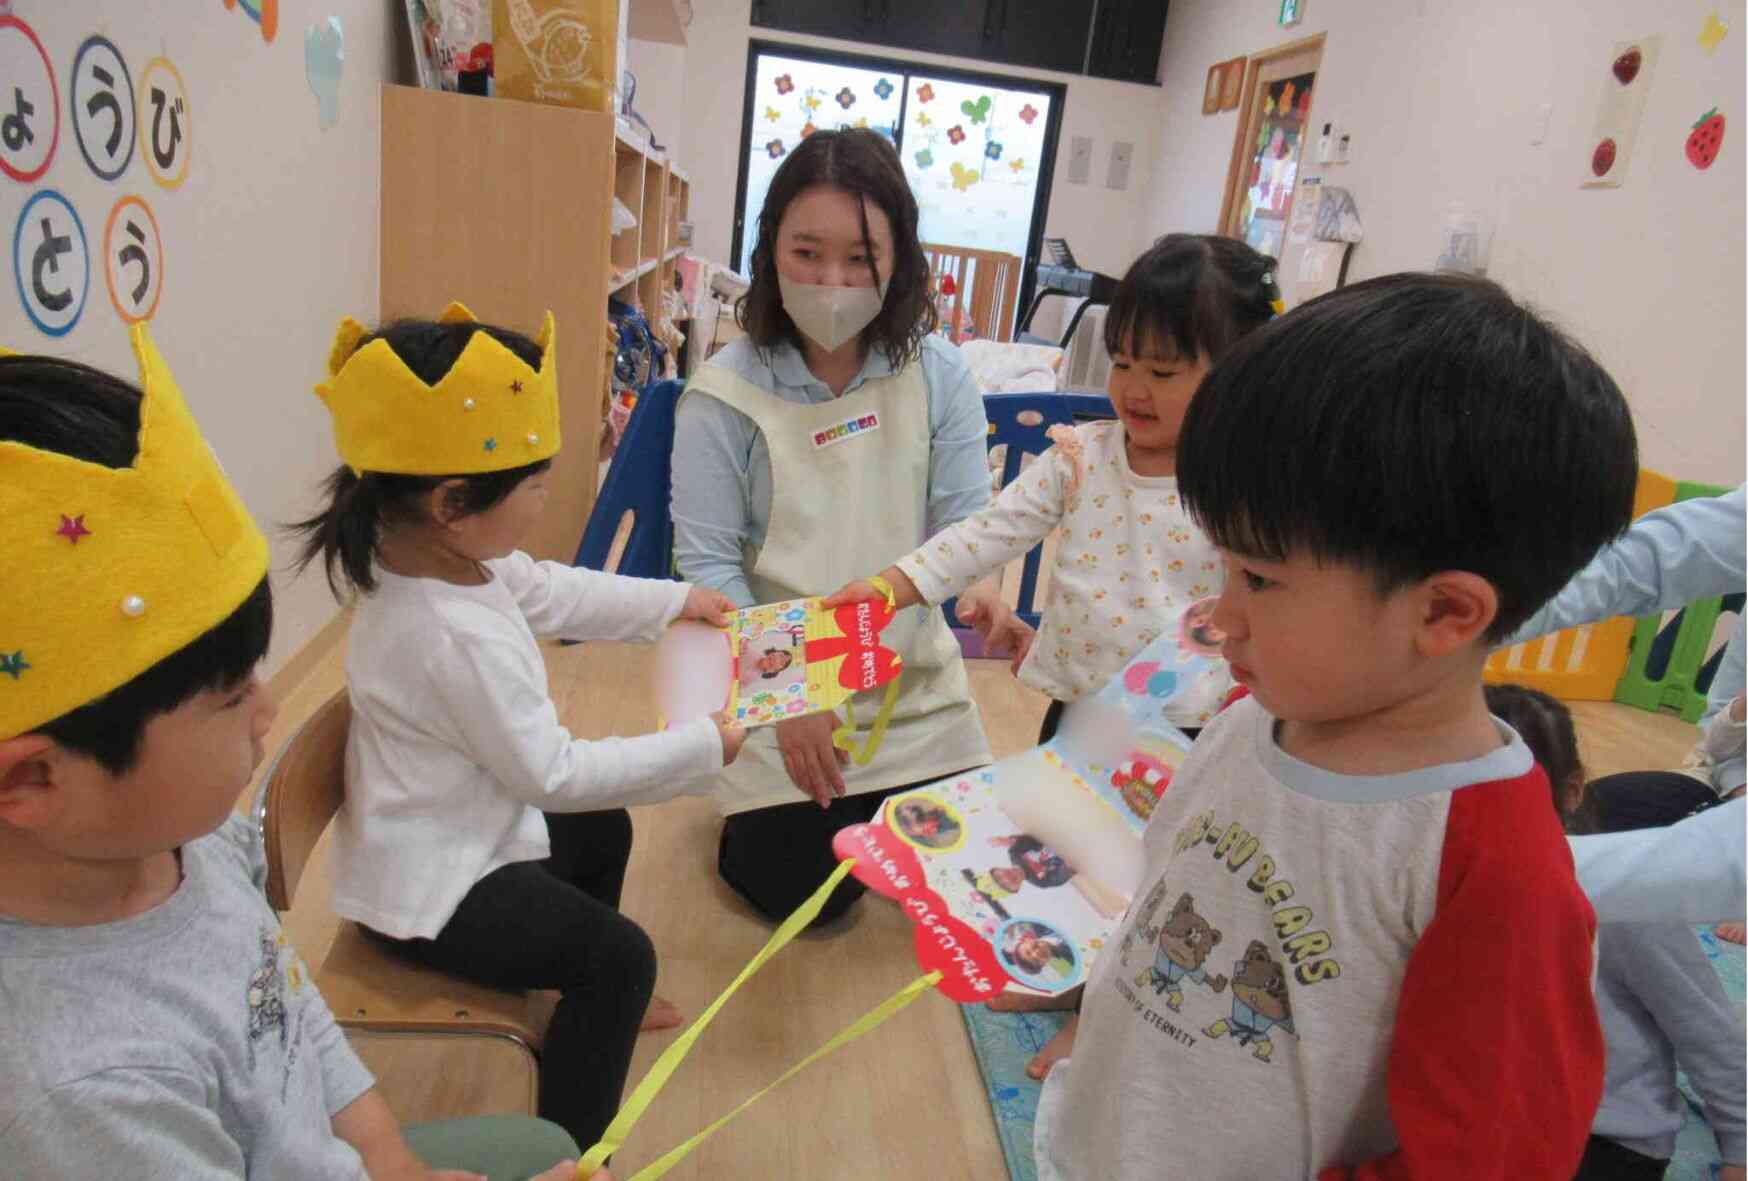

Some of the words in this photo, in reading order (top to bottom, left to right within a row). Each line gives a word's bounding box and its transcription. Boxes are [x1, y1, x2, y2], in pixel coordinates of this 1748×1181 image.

[32, 217, 150, 311] とう
[906, 897, 992, 992] おたんじょうび
[1247, 854, 1341, 986] BEARS
[1143, 1008, 1197, 1049] ETERNITY
